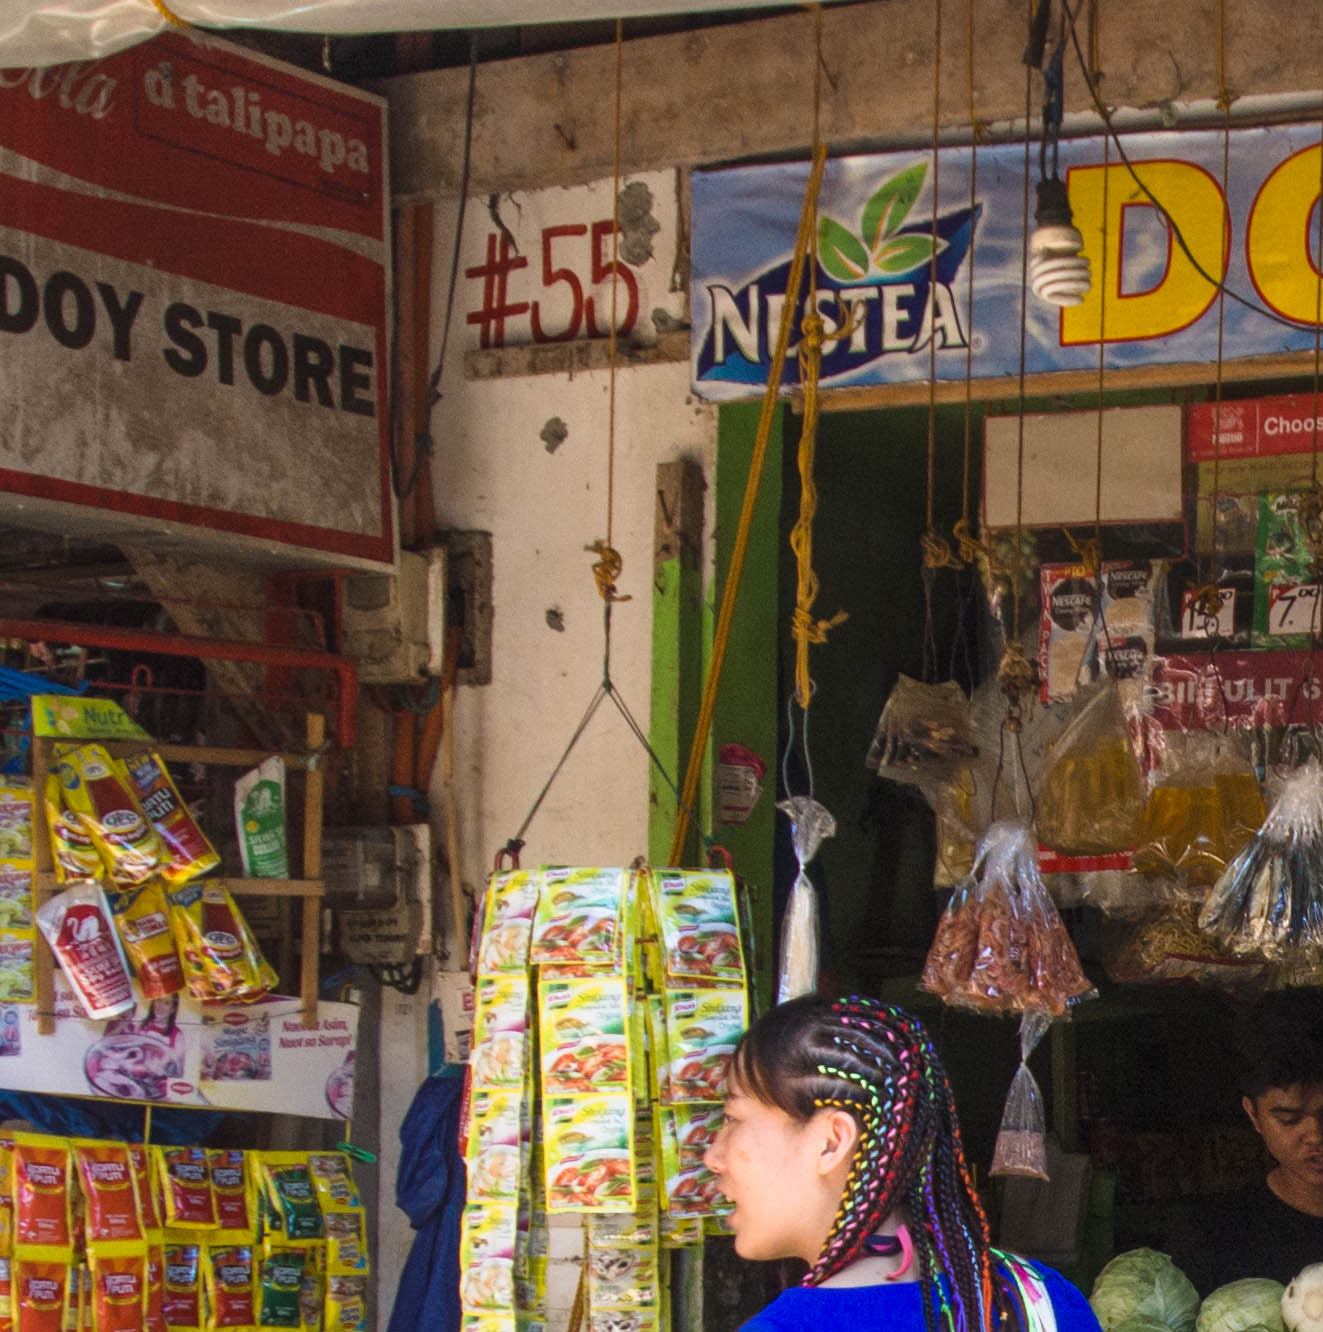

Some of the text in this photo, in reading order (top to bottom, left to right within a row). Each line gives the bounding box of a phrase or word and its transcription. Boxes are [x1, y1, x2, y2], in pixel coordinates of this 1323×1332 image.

[465, 220, 639, 348] #55
[707, 281, 968, 365] NESTEA
[162, 302, 376, 418] STORE
[1223, 676, 1294, 702] ULIT
